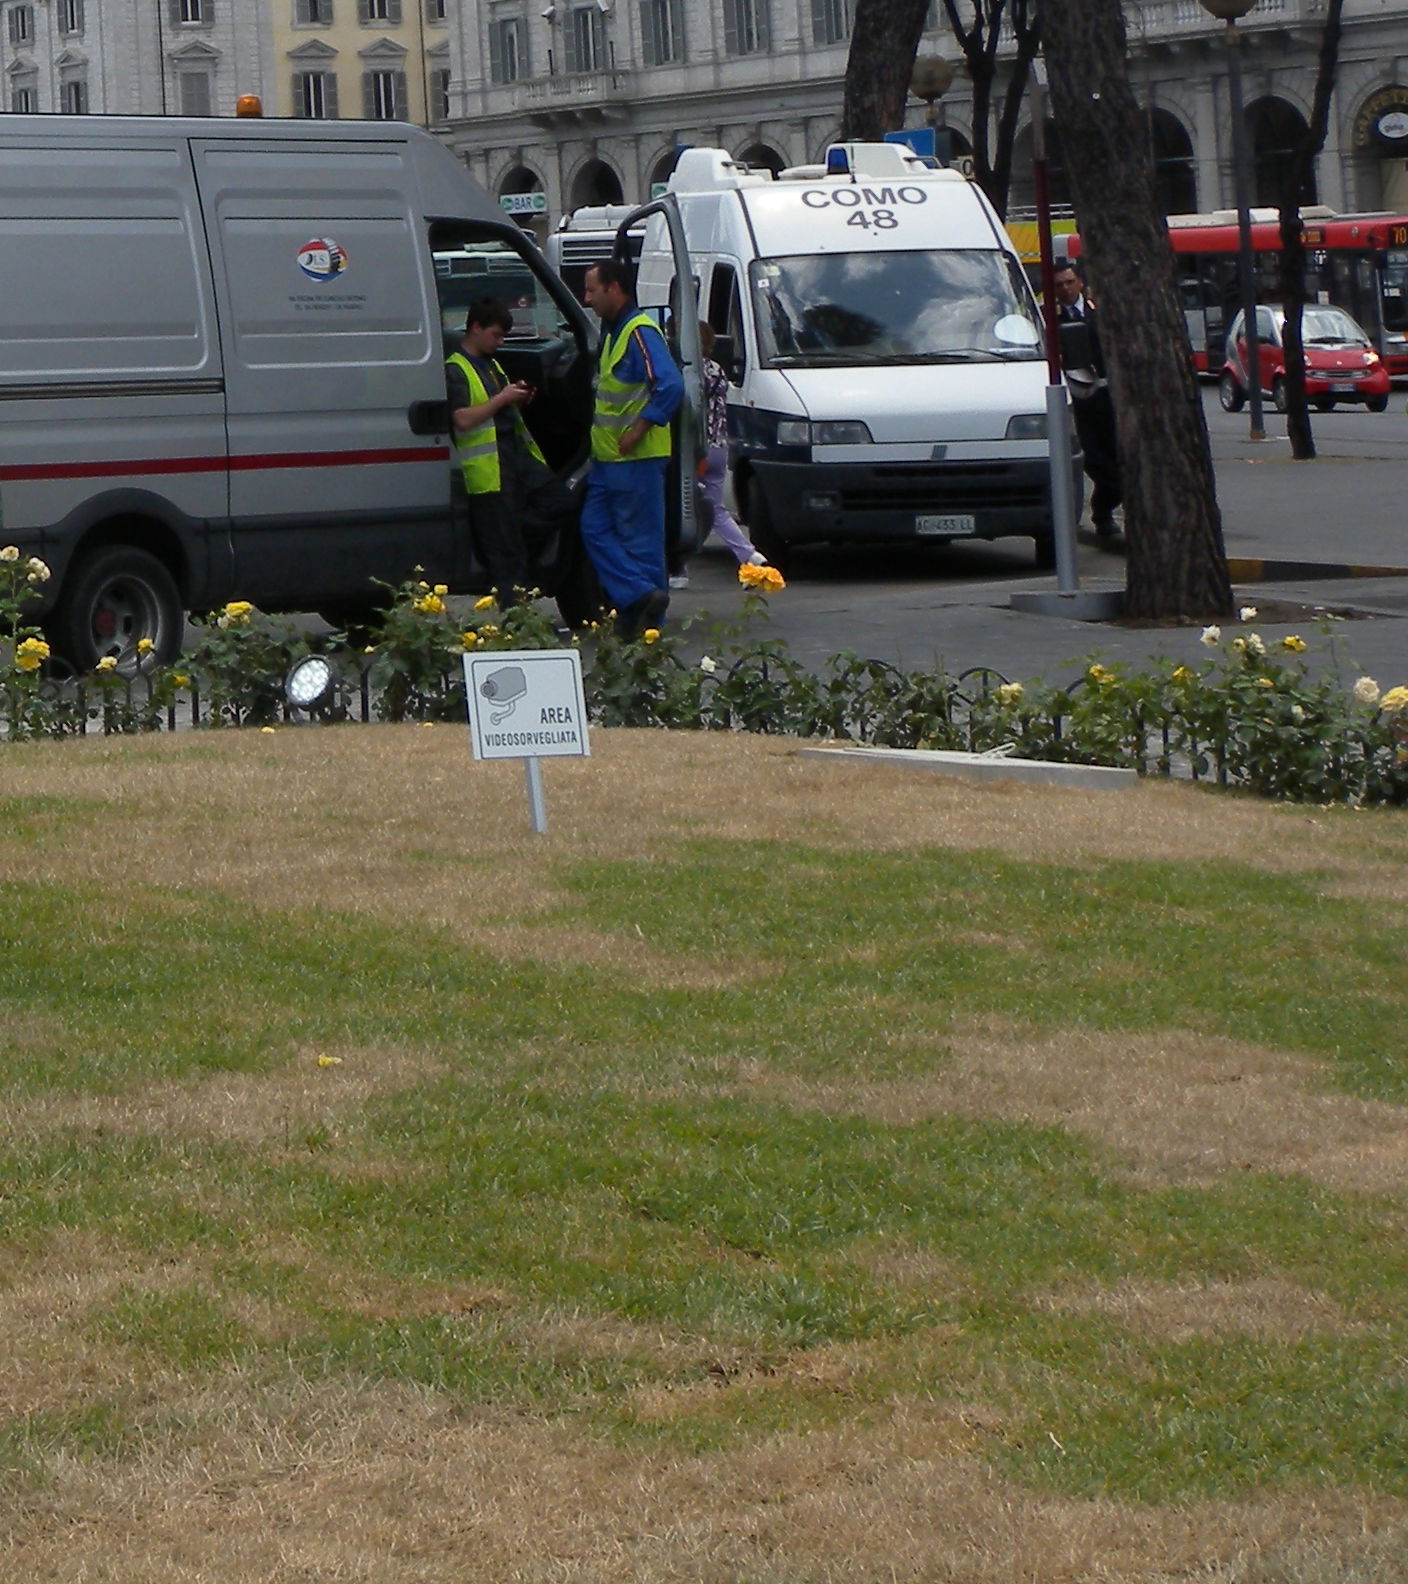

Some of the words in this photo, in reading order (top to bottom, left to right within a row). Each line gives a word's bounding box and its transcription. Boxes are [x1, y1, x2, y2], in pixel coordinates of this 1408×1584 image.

[514, 196, 532, 210] BAR
[801, 186, 927, 208] COMO
[846, 209, 899, 229] 48
[540, 707, 572, 724] AREA
[484, 730, 578, 747] VIDEOSORVEGLIATA
